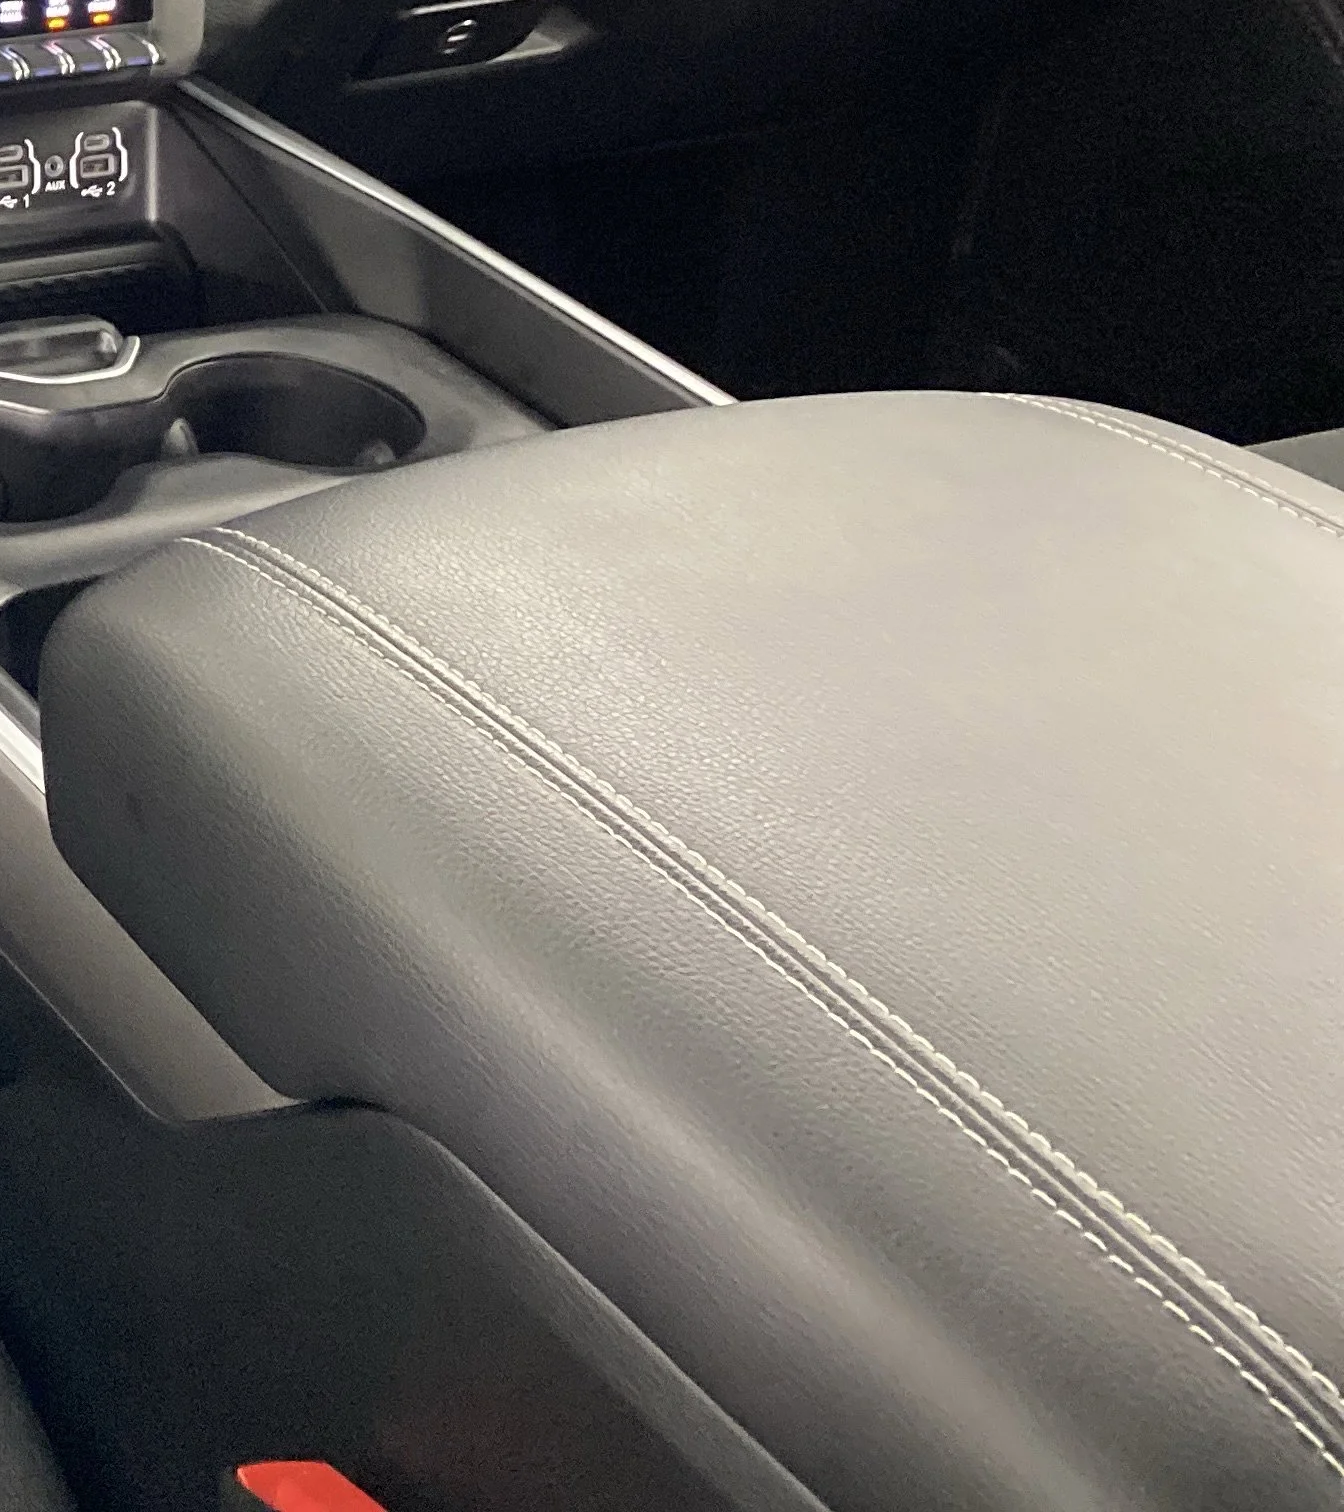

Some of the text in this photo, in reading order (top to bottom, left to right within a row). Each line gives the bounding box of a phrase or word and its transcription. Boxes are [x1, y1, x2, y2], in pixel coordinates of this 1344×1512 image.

[44, 181, 66, 192] AUX
[107, 181, 116, 196] 2
[23, 194, 29, 208] 1
